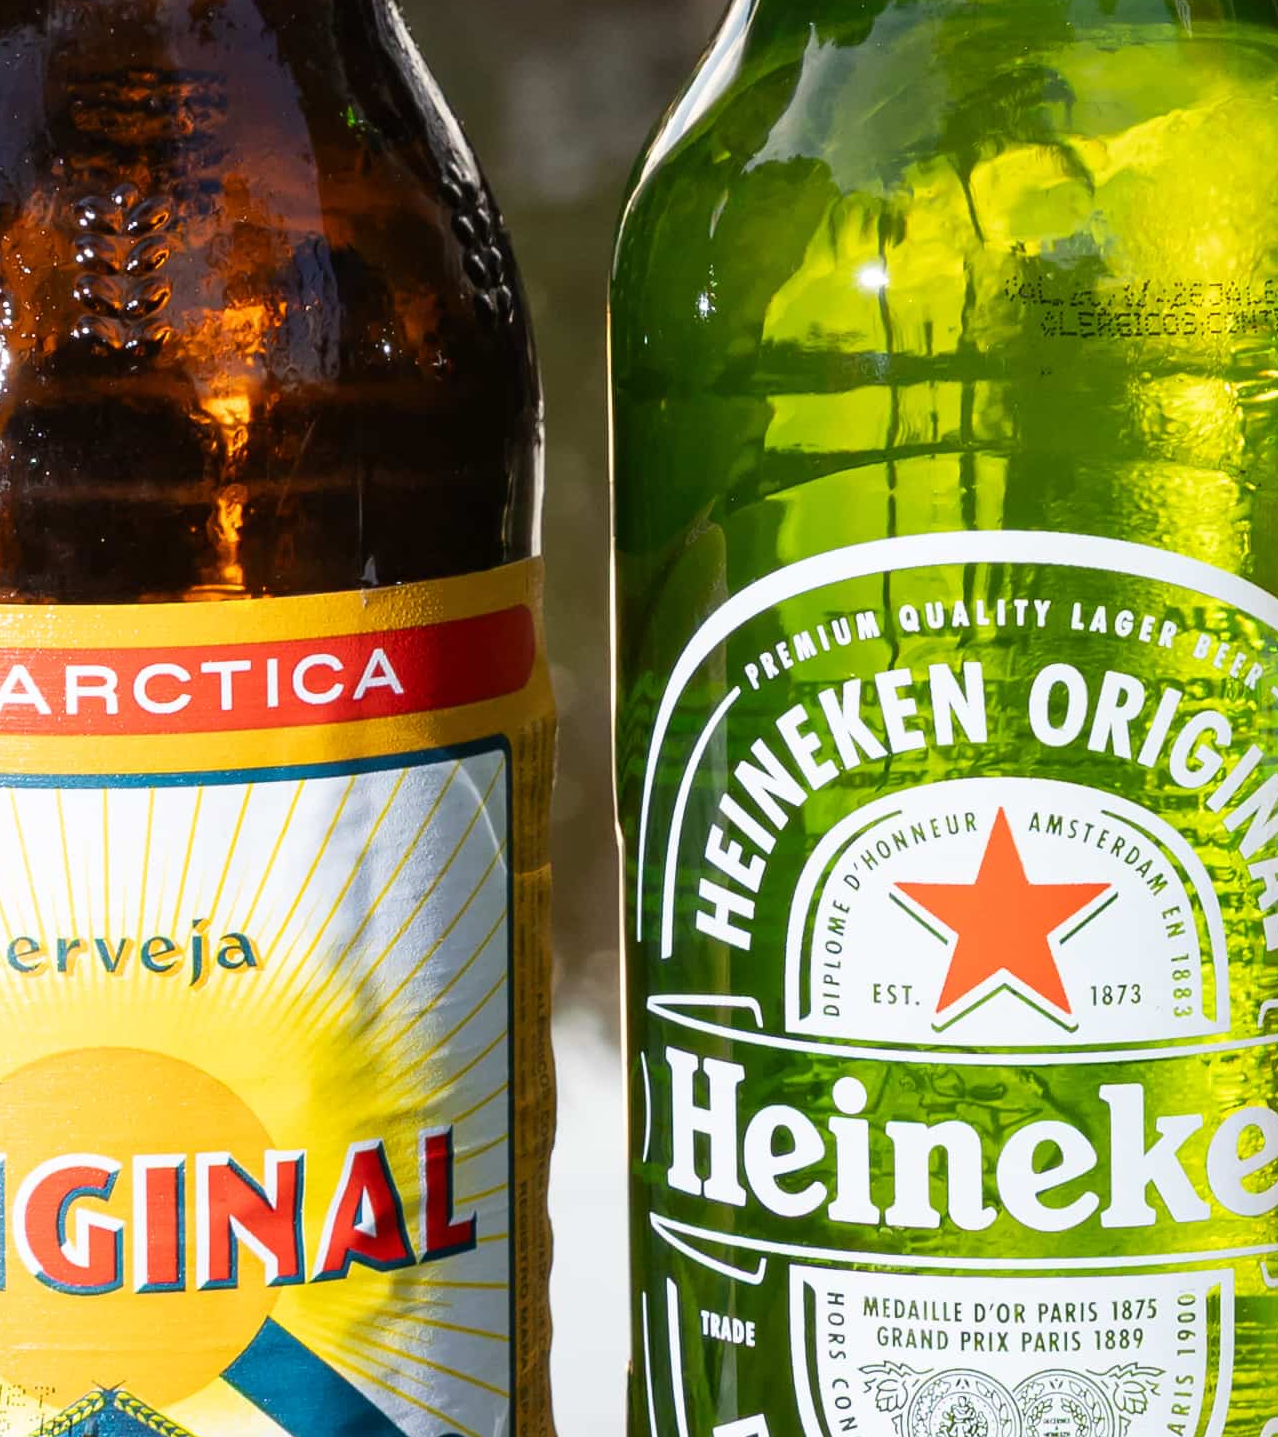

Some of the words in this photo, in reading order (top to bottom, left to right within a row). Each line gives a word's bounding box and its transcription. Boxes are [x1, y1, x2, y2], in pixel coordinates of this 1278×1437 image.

[744, 609, 882, 691] PREMIUM
[899, 597, 1053, 634] QUALITY
[1070, 602, 1177, 650] LAGER
[1193, 632, 1265, 693] BEER
[695, 661, 989, 953] HEINEKEN
[1027, 810, 1170, 897] AMSTERDAM
[1161, 903, 1187, 942] EN
[822, 896, 852, 1018] DIPLOME
[872, 982, 921, 1008] EST.
[1089, 981, 1144, 1008] 1873
[1168, 951, 1195, 1020] 1883
[698, 1308, 757, 1352] TRADE
[825, 1290, 849, 1363] HORS
[1174, 1289, 1197, 1359] 1900
[862, 1295, 967, 1323] MEDAILLE
[1036, 1297, 1099, 1325] PARIS
[1109, 1295, 1160, 1324] 1875
[875, 1326, 950, 1353] GRAND
[960, 1326, 1012, 1354] PRIX
[1021, 1328, 1081, 1353] PARIS
[1094, 1325, 1146, 1352] 1889
